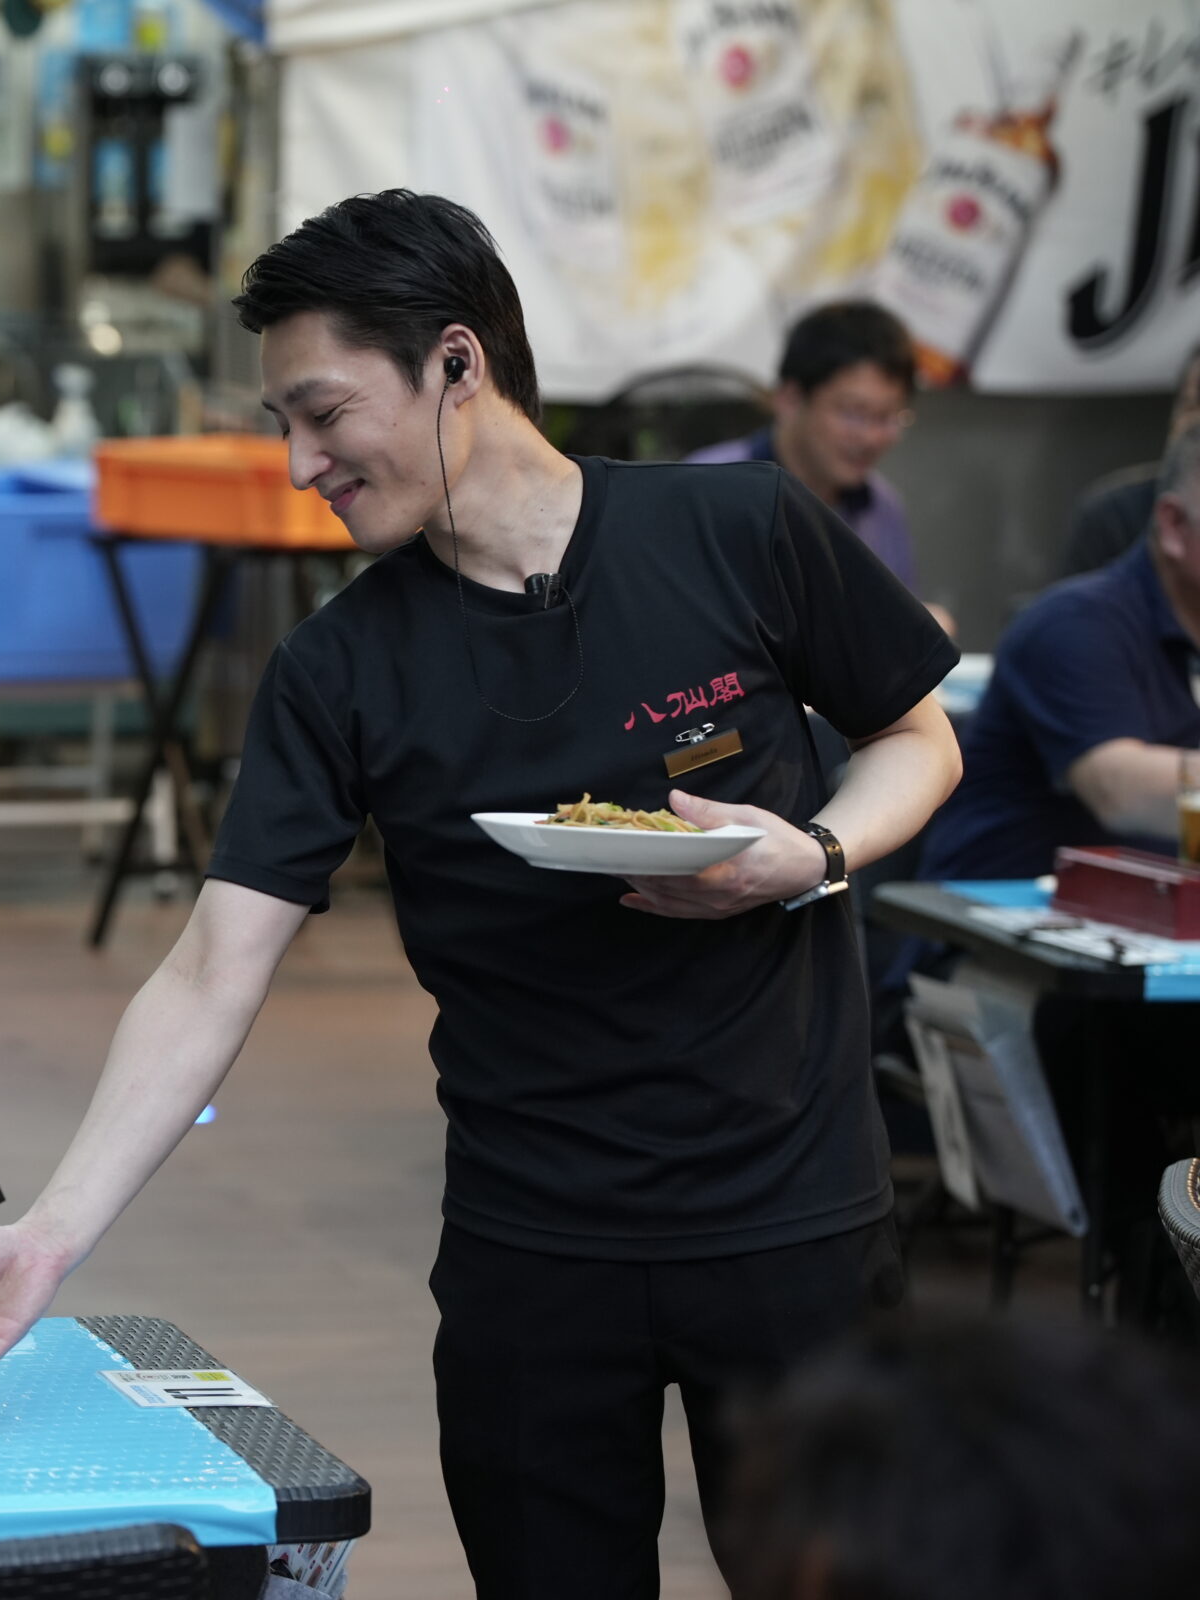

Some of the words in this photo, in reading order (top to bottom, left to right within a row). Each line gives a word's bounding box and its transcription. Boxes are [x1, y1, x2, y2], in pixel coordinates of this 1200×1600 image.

[1065, 97, 1200, 352] J
[624, 671, 745, 731] 八仙閣
